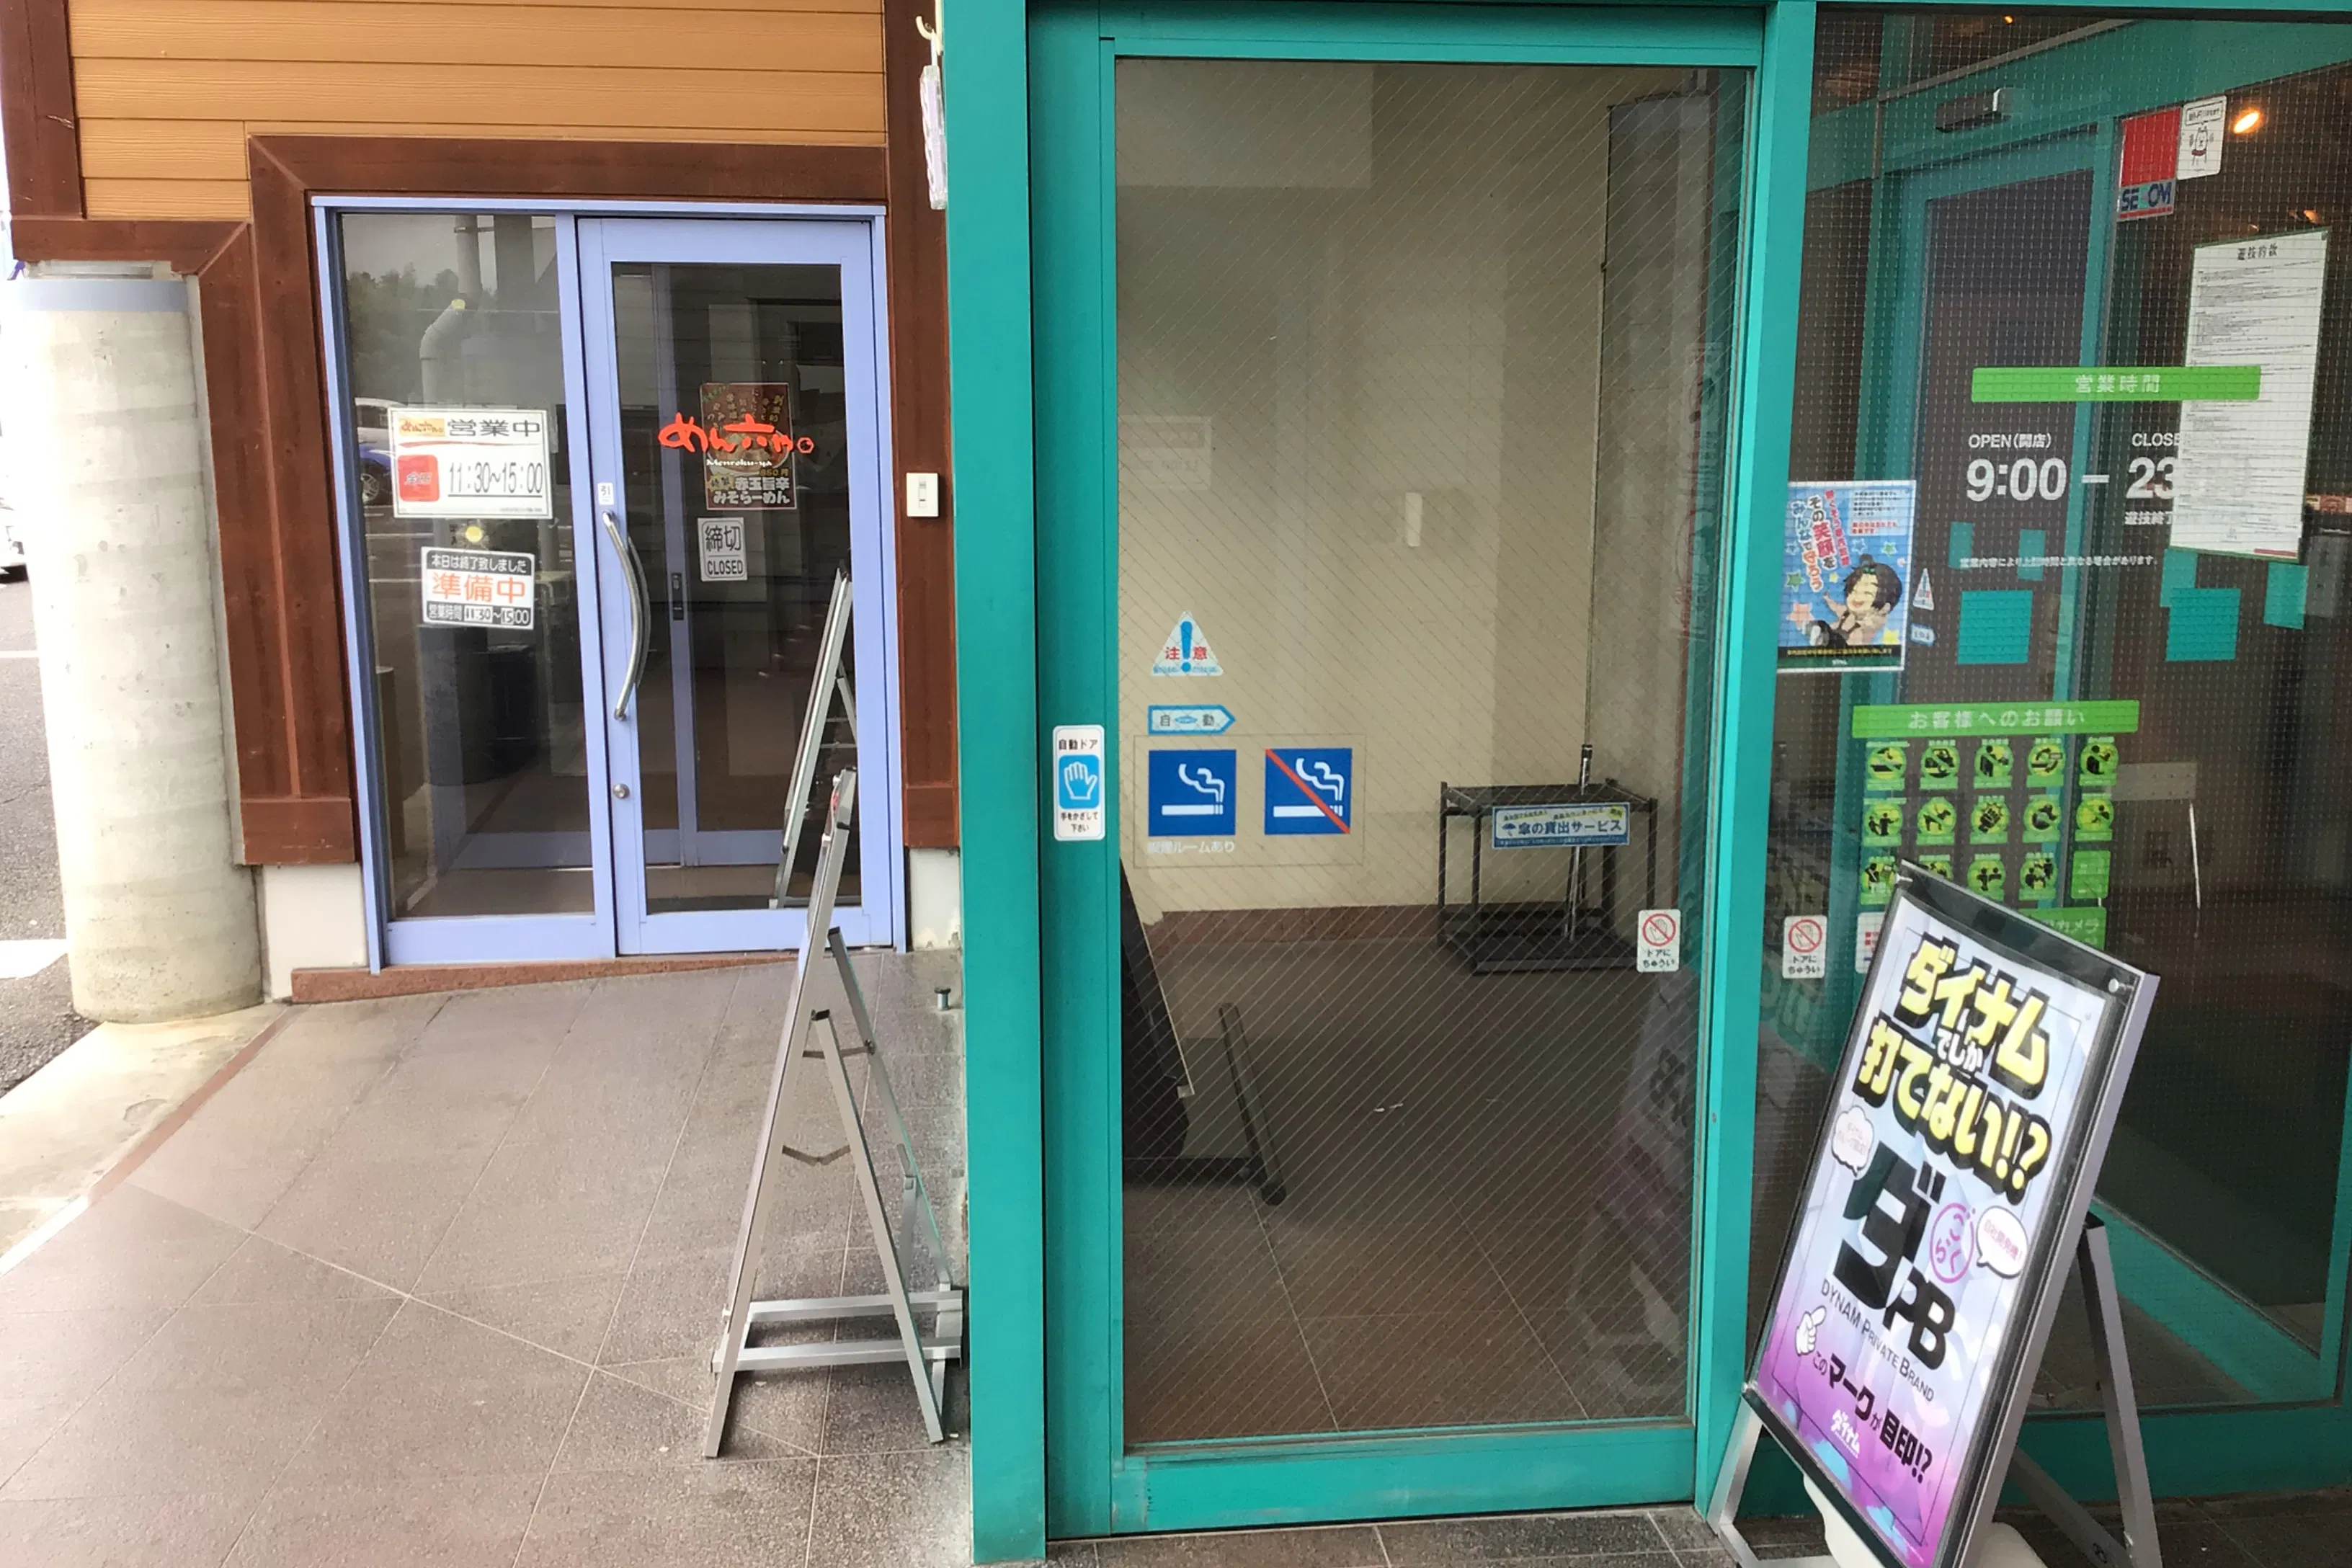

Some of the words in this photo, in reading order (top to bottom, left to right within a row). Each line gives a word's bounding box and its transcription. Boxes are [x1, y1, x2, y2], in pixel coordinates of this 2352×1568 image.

[2075, 374, 2160, 393] 営業時間
[447, 419, 540, 437] 営業中
[1966, 458, 2067, 502] 9:00
[713, 491, 790, 504] みそらーめん
[705, 525, 741, 552] 締切
[432, 553, 527, 574] 本日は終了致しました
[707, 560, 744, 575] CLOSED
[432, 571, 525, 604] 準備中
[1908, 708, 2086, 729] お客様へのお願い
[1059, 739, 1098, 750] 自動ドア
[1061, 811, 1099, 821] 手をかざして
[1071, 824, 1090, 833] 下さい
[1518, 819, 1622, 835] 傘の貸出サービス
[1642, 959, 1676, 968] ちゅうい
[1787, 966, 1821, 974] ちゅうい
[1897, 935, 2049, 1090] ダイナム
[1936, 1028, 1983, 1076] でしか
[1821, 1278, 1861, 1329] DYNAM
